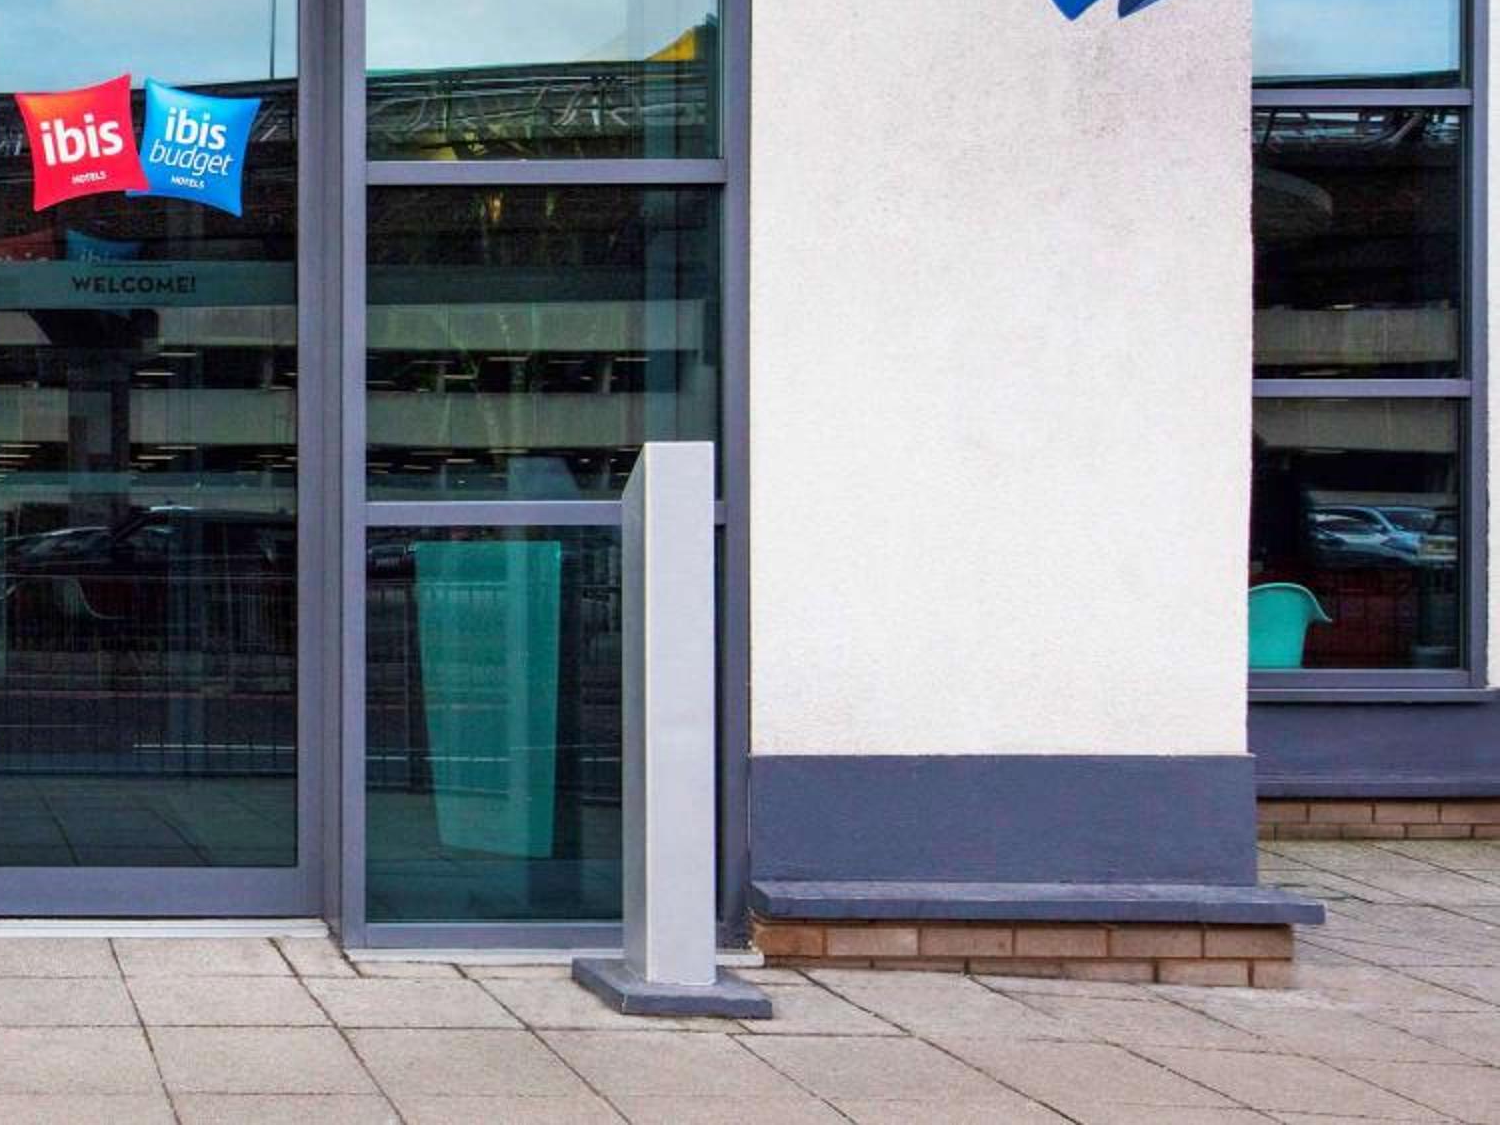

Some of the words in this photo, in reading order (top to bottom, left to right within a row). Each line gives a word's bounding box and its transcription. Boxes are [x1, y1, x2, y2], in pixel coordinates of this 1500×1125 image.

[38, 113, 125, 167] ibis
[164, 106, 228, 151] ibis
[71, 169, 107, 185] HOTELS
[149, 138, 234, 177] budget
[71, 275, 197, 294] WELCOME!
